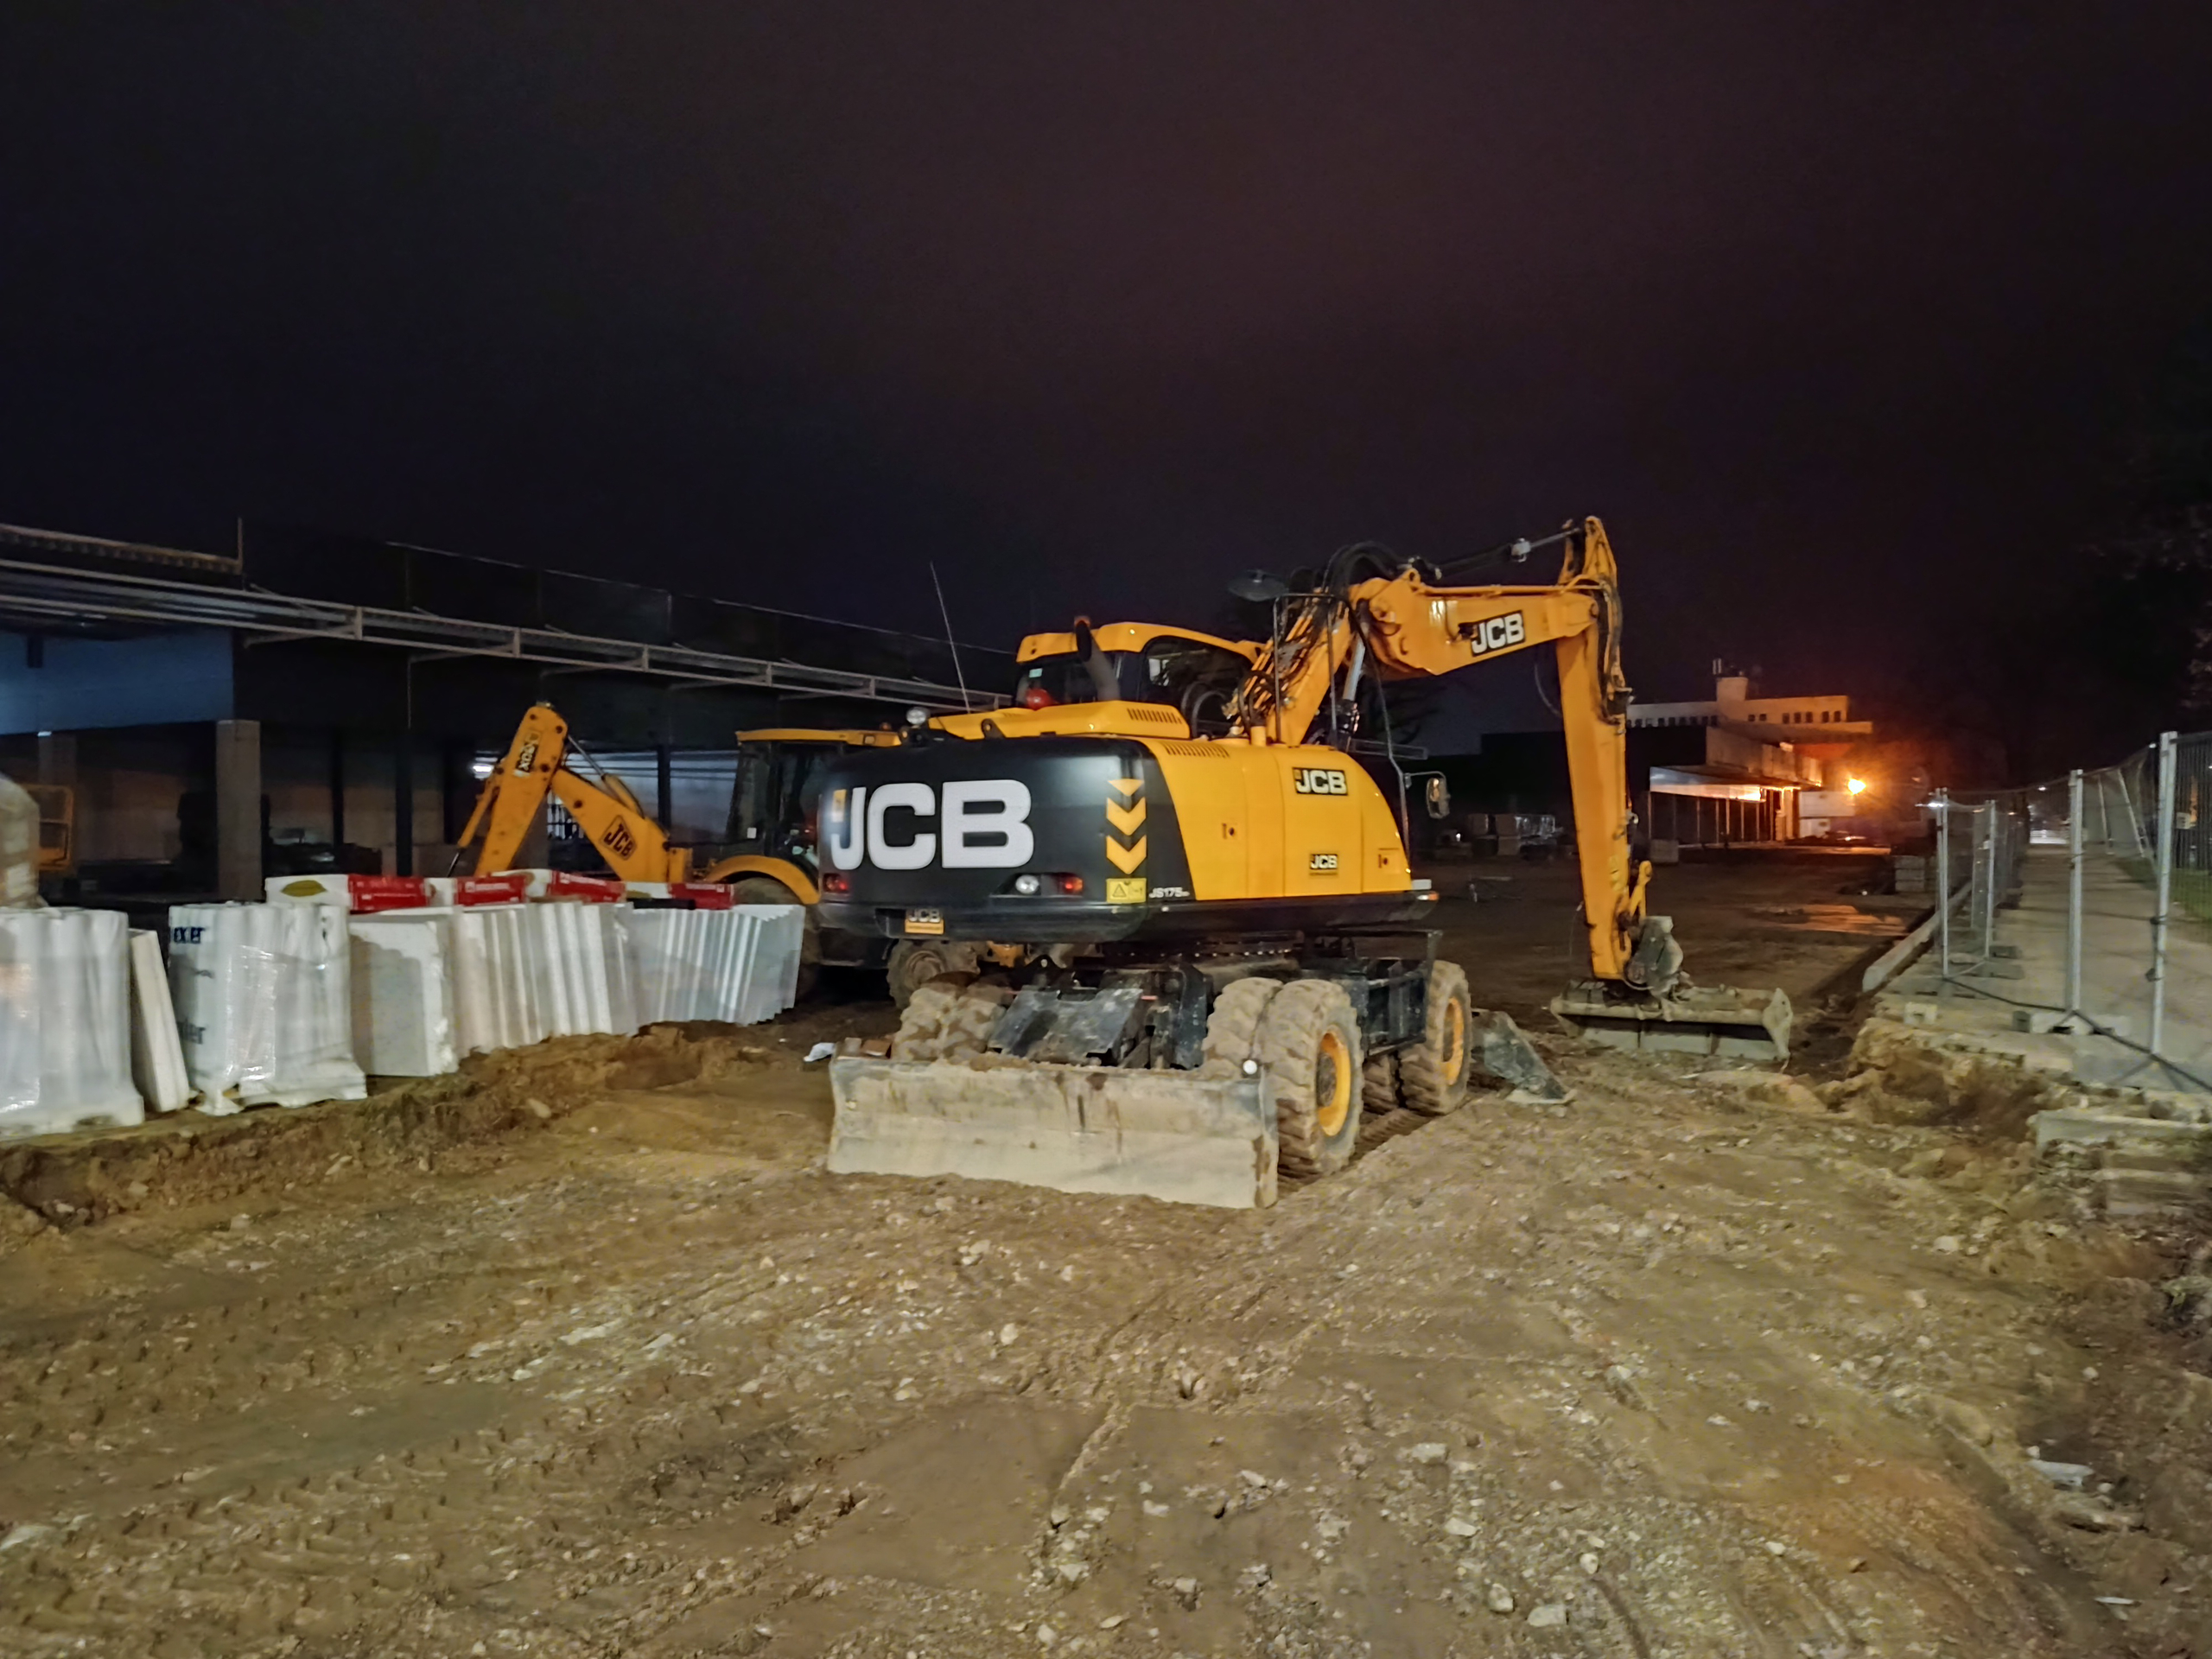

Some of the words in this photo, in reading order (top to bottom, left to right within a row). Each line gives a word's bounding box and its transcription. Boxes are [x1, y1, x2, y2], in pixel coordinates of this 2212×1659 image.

[1471, 613, 1525, 654] JCB
[1296, 769, 1347, 794] JCB
[831, 779, 1034, 870] JCB
[603, 823, 633, 856] JCB
[1311, 855, 1338, 869] JCB
[908, 908, 941, 923] JCB
